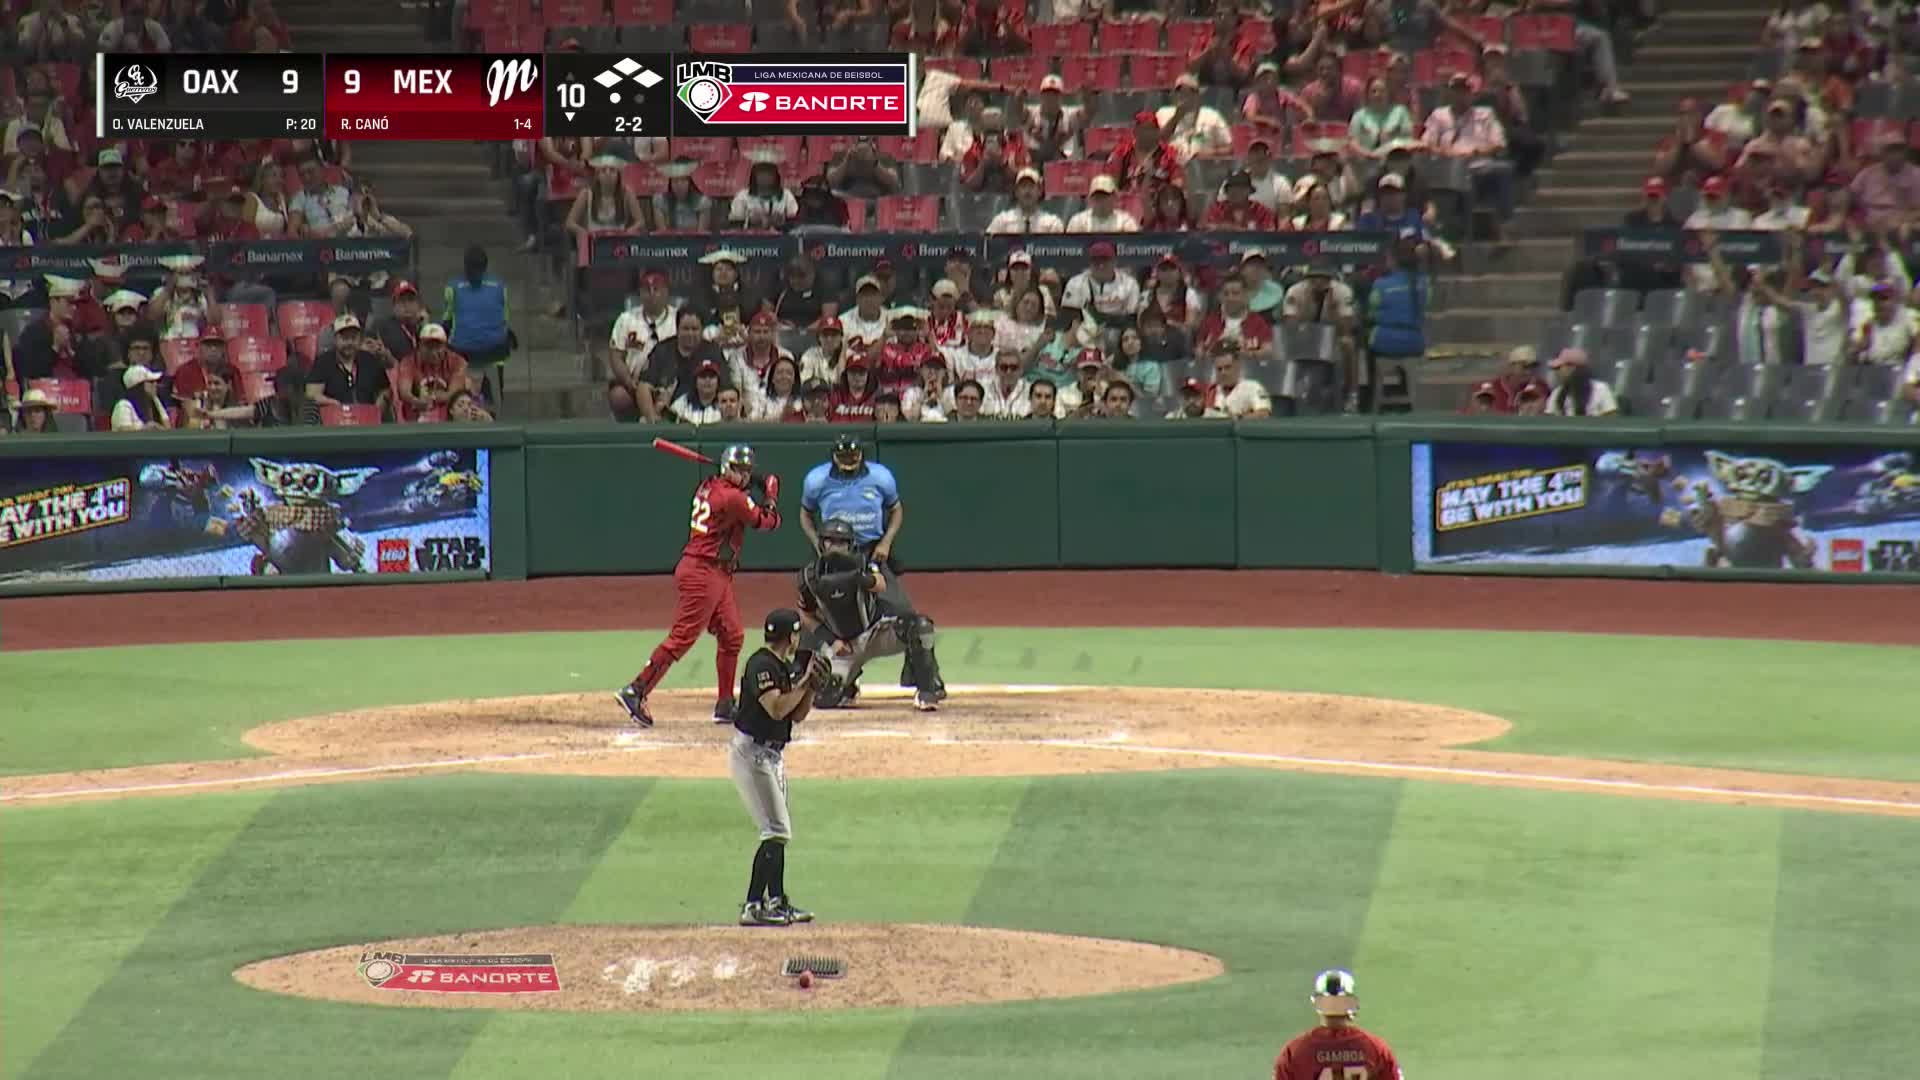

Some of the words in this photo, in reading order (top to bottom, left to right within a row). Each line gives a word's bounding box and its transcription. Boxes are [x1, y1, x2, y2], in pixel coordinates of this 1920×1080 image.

[827, 244, 886, 257] Banamex
[0, 502, 34, 524] AY
[39, 490, 88, 517] THE
[90, 481, 127, 506] 4TH
[1440, 485, 1495, 509] MAY
[1498, 475, 1546, 499] THE
[1440, 505, 1472, 526] BE
[1474, 498, 1533, 521] WITH
[1536, 487, 1584, 509] YOU
[0, 523, 13, 543] E
[12, 510, 77, 540] WITH
[77, 499, 127, 526] YOU
[690, 496, 711, 533] 22
[440, 972, 553, 985] BANORTE
